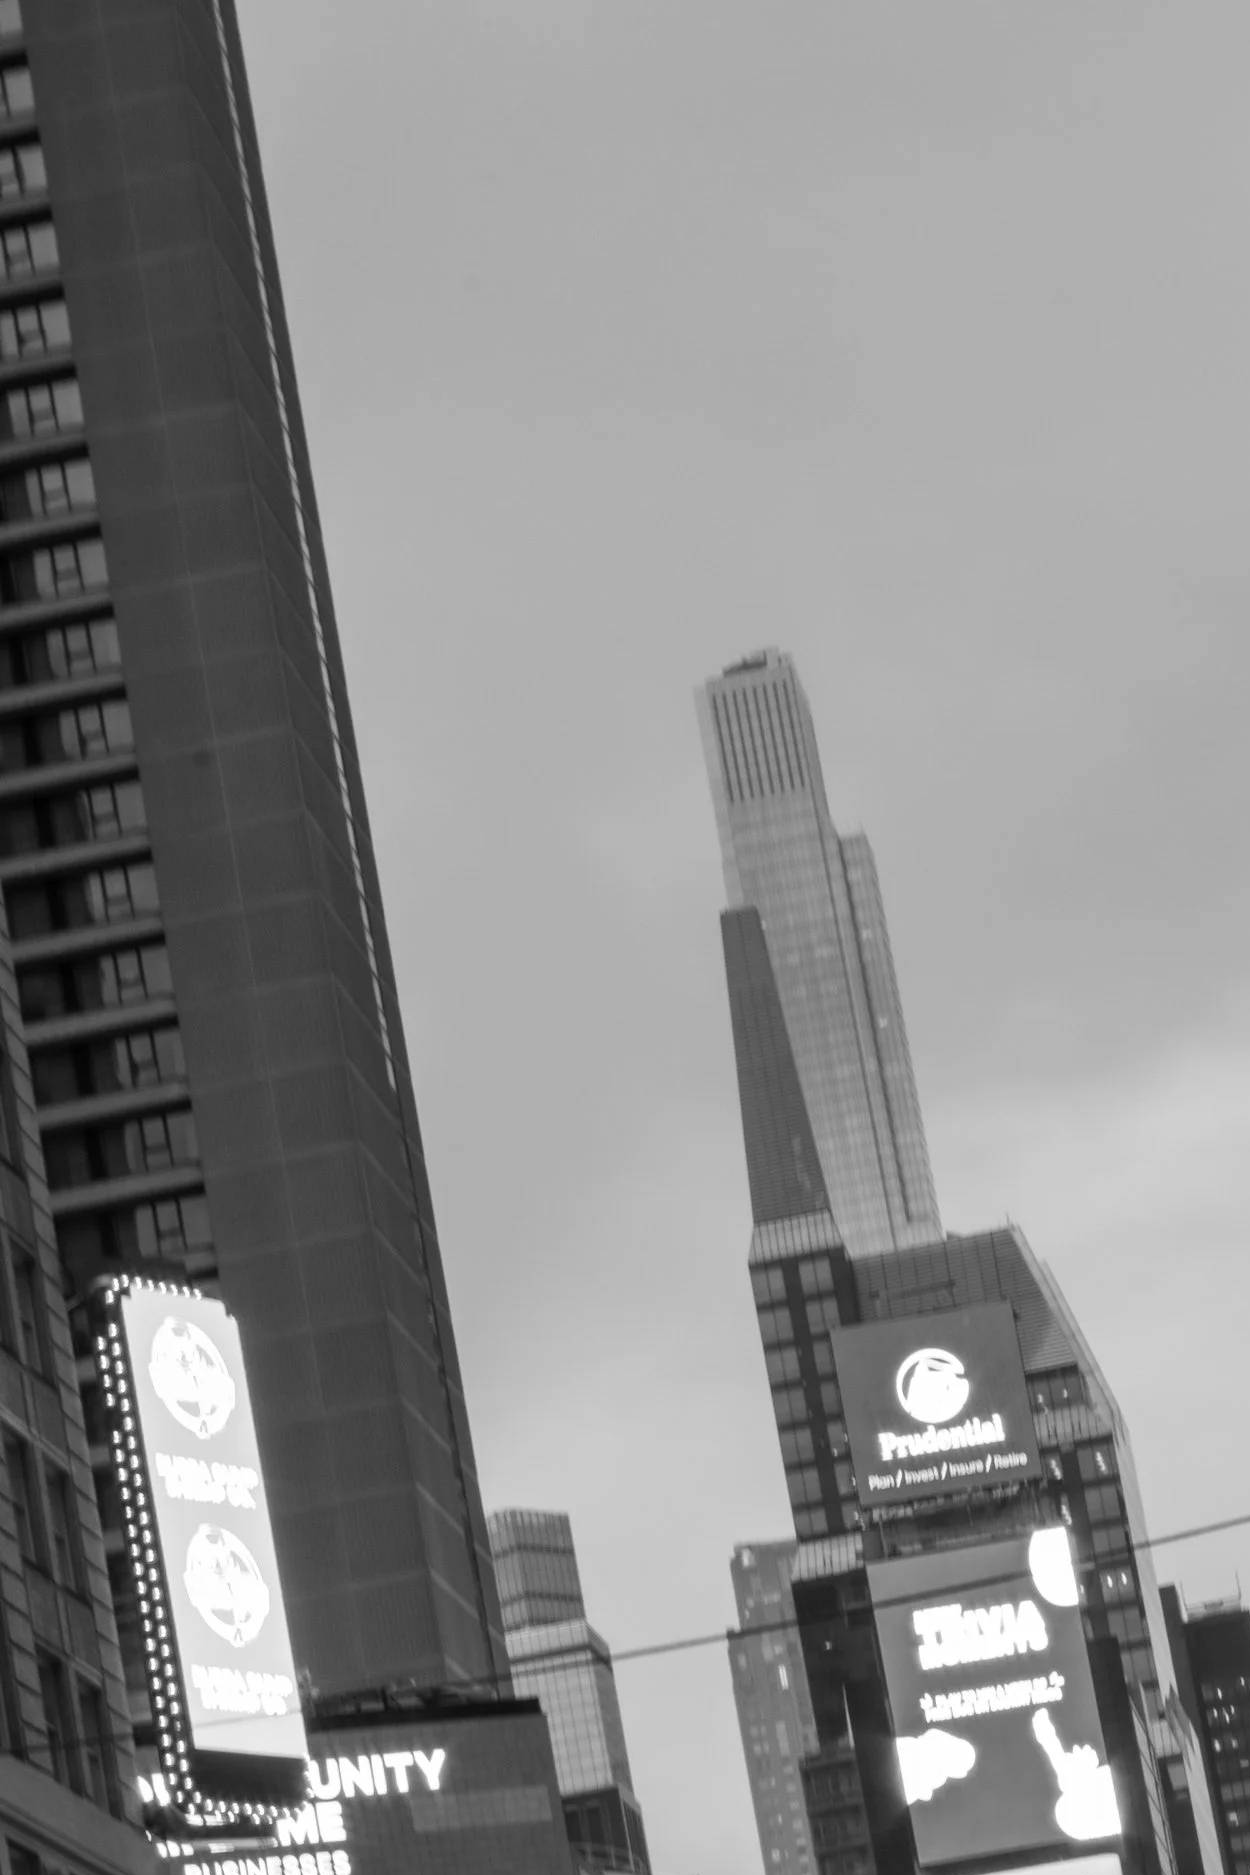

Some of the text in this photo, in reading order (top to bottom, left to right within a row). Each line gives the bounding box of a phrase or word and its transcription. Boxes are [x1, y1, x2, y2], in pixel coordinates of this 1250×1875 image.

[878, 1413, 1006, 1461] Prudential
[868, 1474, 895, 1491] Plan
[904, 1466, 940, 1485] Invest
